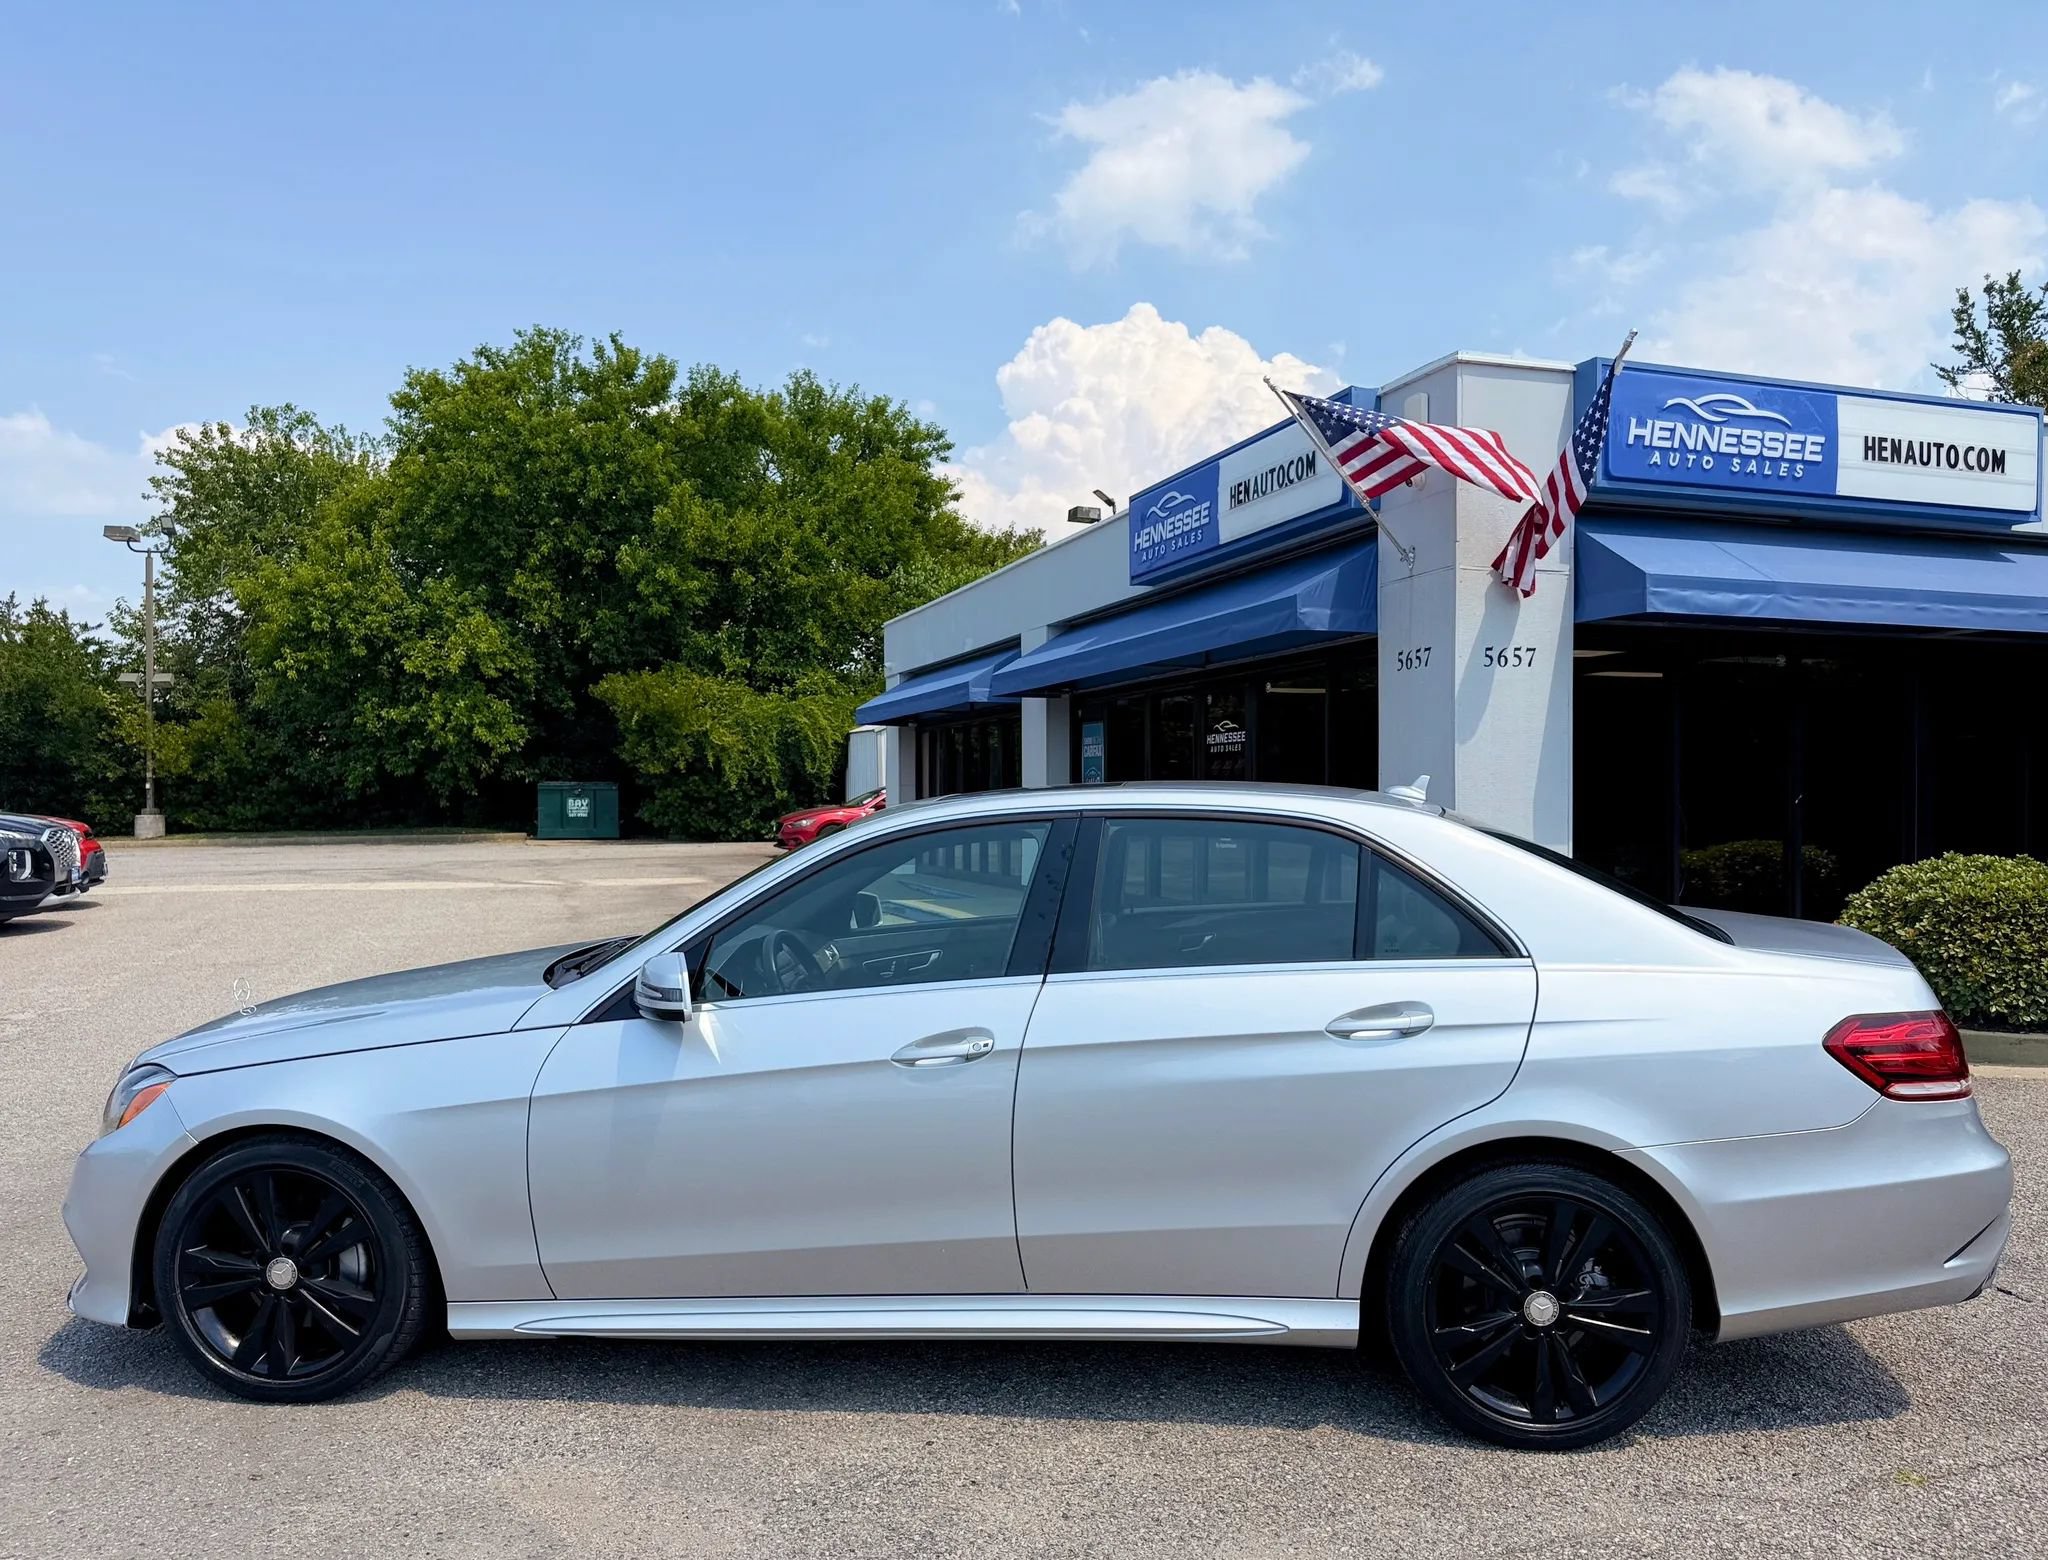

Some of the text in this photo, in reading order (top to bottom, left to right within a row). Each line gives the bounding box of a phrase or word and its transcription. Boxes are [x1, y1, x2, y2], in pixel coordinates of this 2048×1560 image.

[1628, 417, 1826, 463] HENNESSEE
[1649, 450, 1806, 479] AUTO SALES
[1134, 501, 1211, 552] HENNESSEE
[1141, 529, 1203, 562] AUTO SALES
[1397, 647, 1432, 671] 5657
[1484, 646, 1537, 667] 5657
[1206, 731, 1246, 745] HENNESSEE
[1210, 743, 1242, 753] AUTO SALES
[568, 799, 588, 807] BAY
